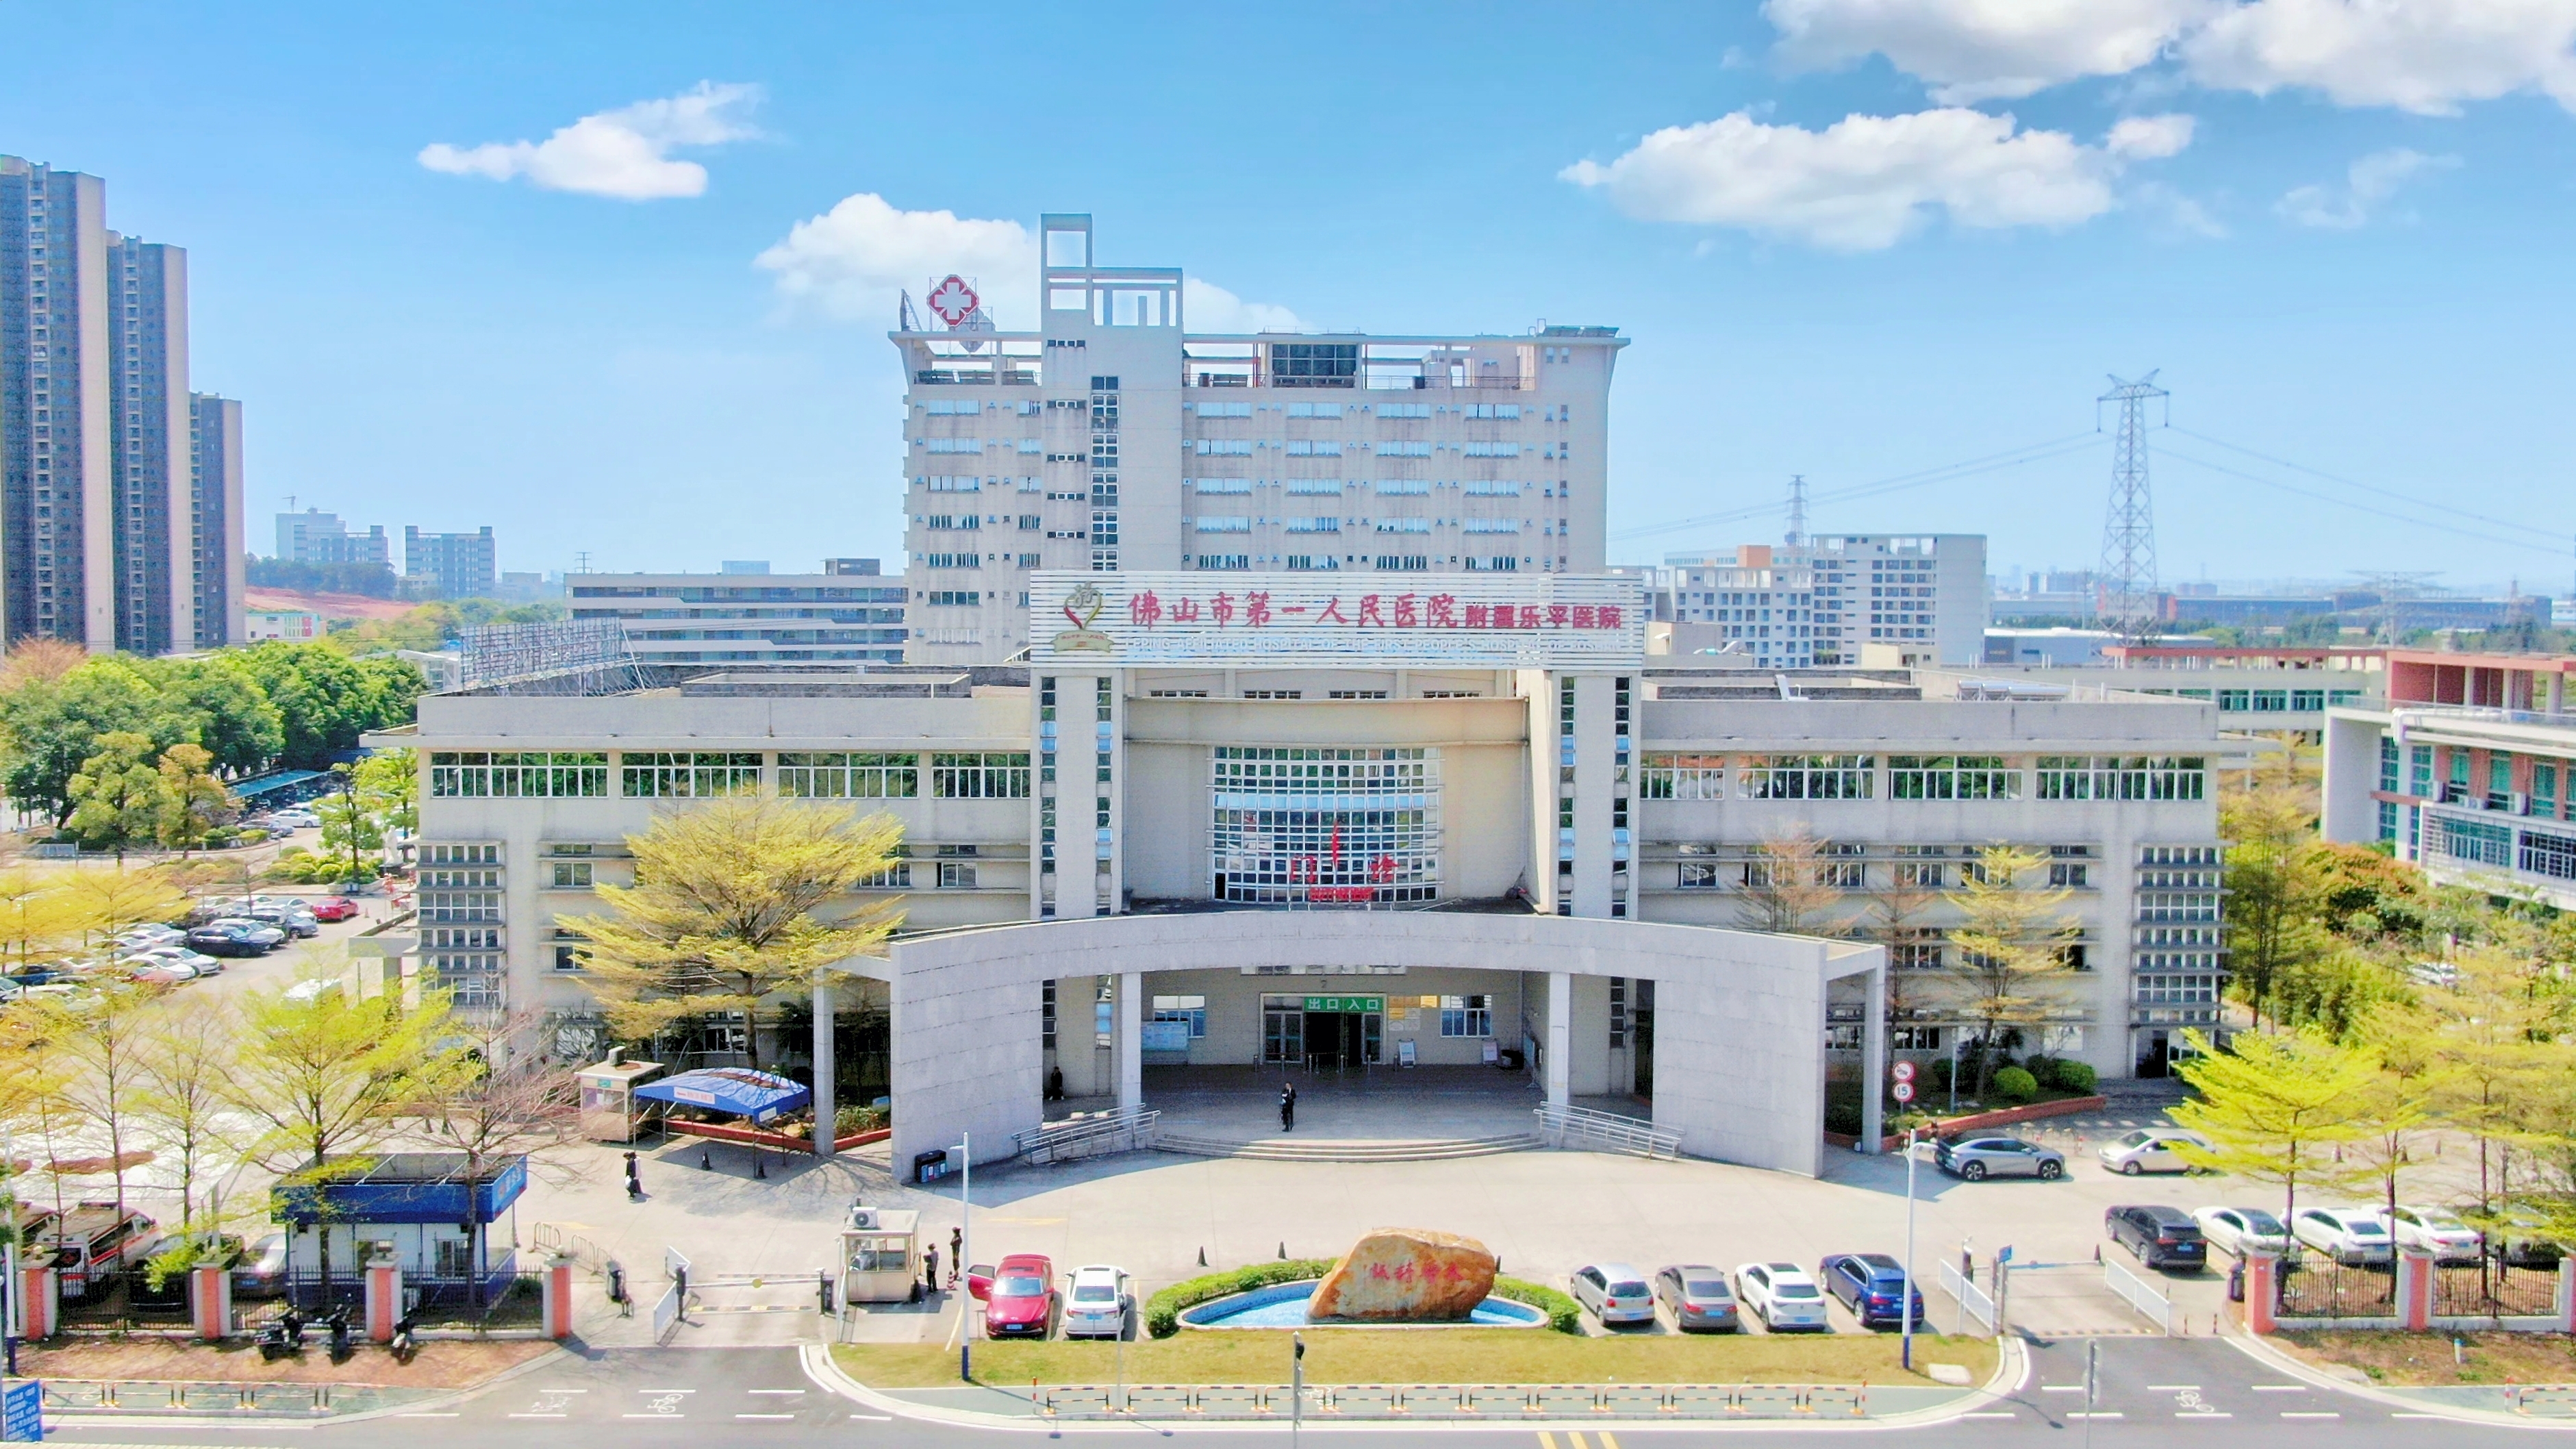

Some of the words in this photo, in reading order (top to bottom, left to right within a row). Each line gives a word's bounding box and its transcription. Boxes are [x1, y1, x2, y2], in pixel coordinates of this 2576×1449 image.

[1126, 637, 1171, 650] LEPING
[1253, 638, 1312, 650] HOSPITAL
[1321, 638, 1337, 650] OF
[1374, 638, 1410, 650] FIRST
[1897, 1086, 1908, 1096] 15
